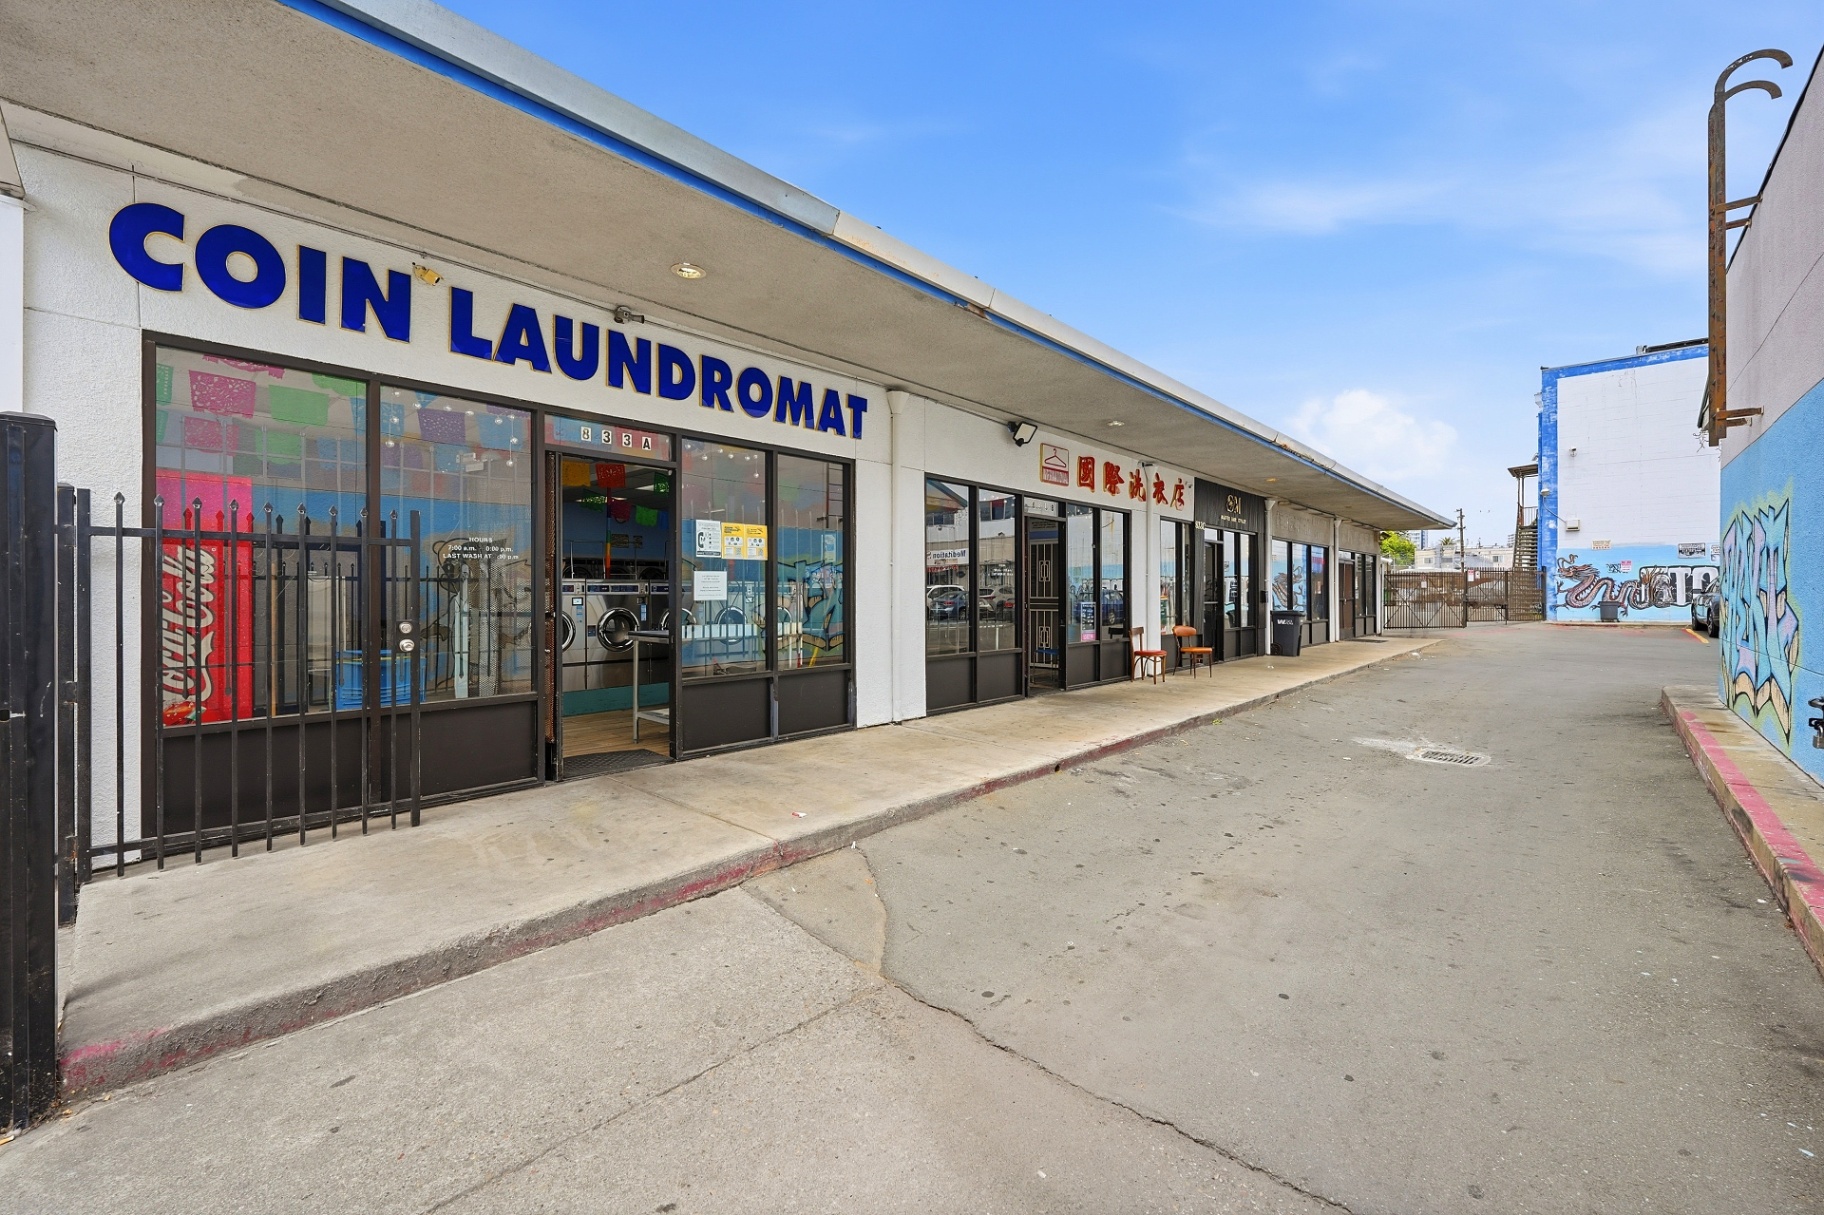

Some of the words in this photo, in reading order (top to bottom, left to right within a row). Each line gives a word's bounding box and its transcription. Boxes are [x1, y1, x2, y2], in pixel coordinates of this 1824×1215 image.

[109, 202, 412, 343] COIN
[449, 285, 868, 440] LAUNDROMAT
[582, 427, 651, 450] 833A
[1077, 455, 1186, 512] 國際洗衣店
